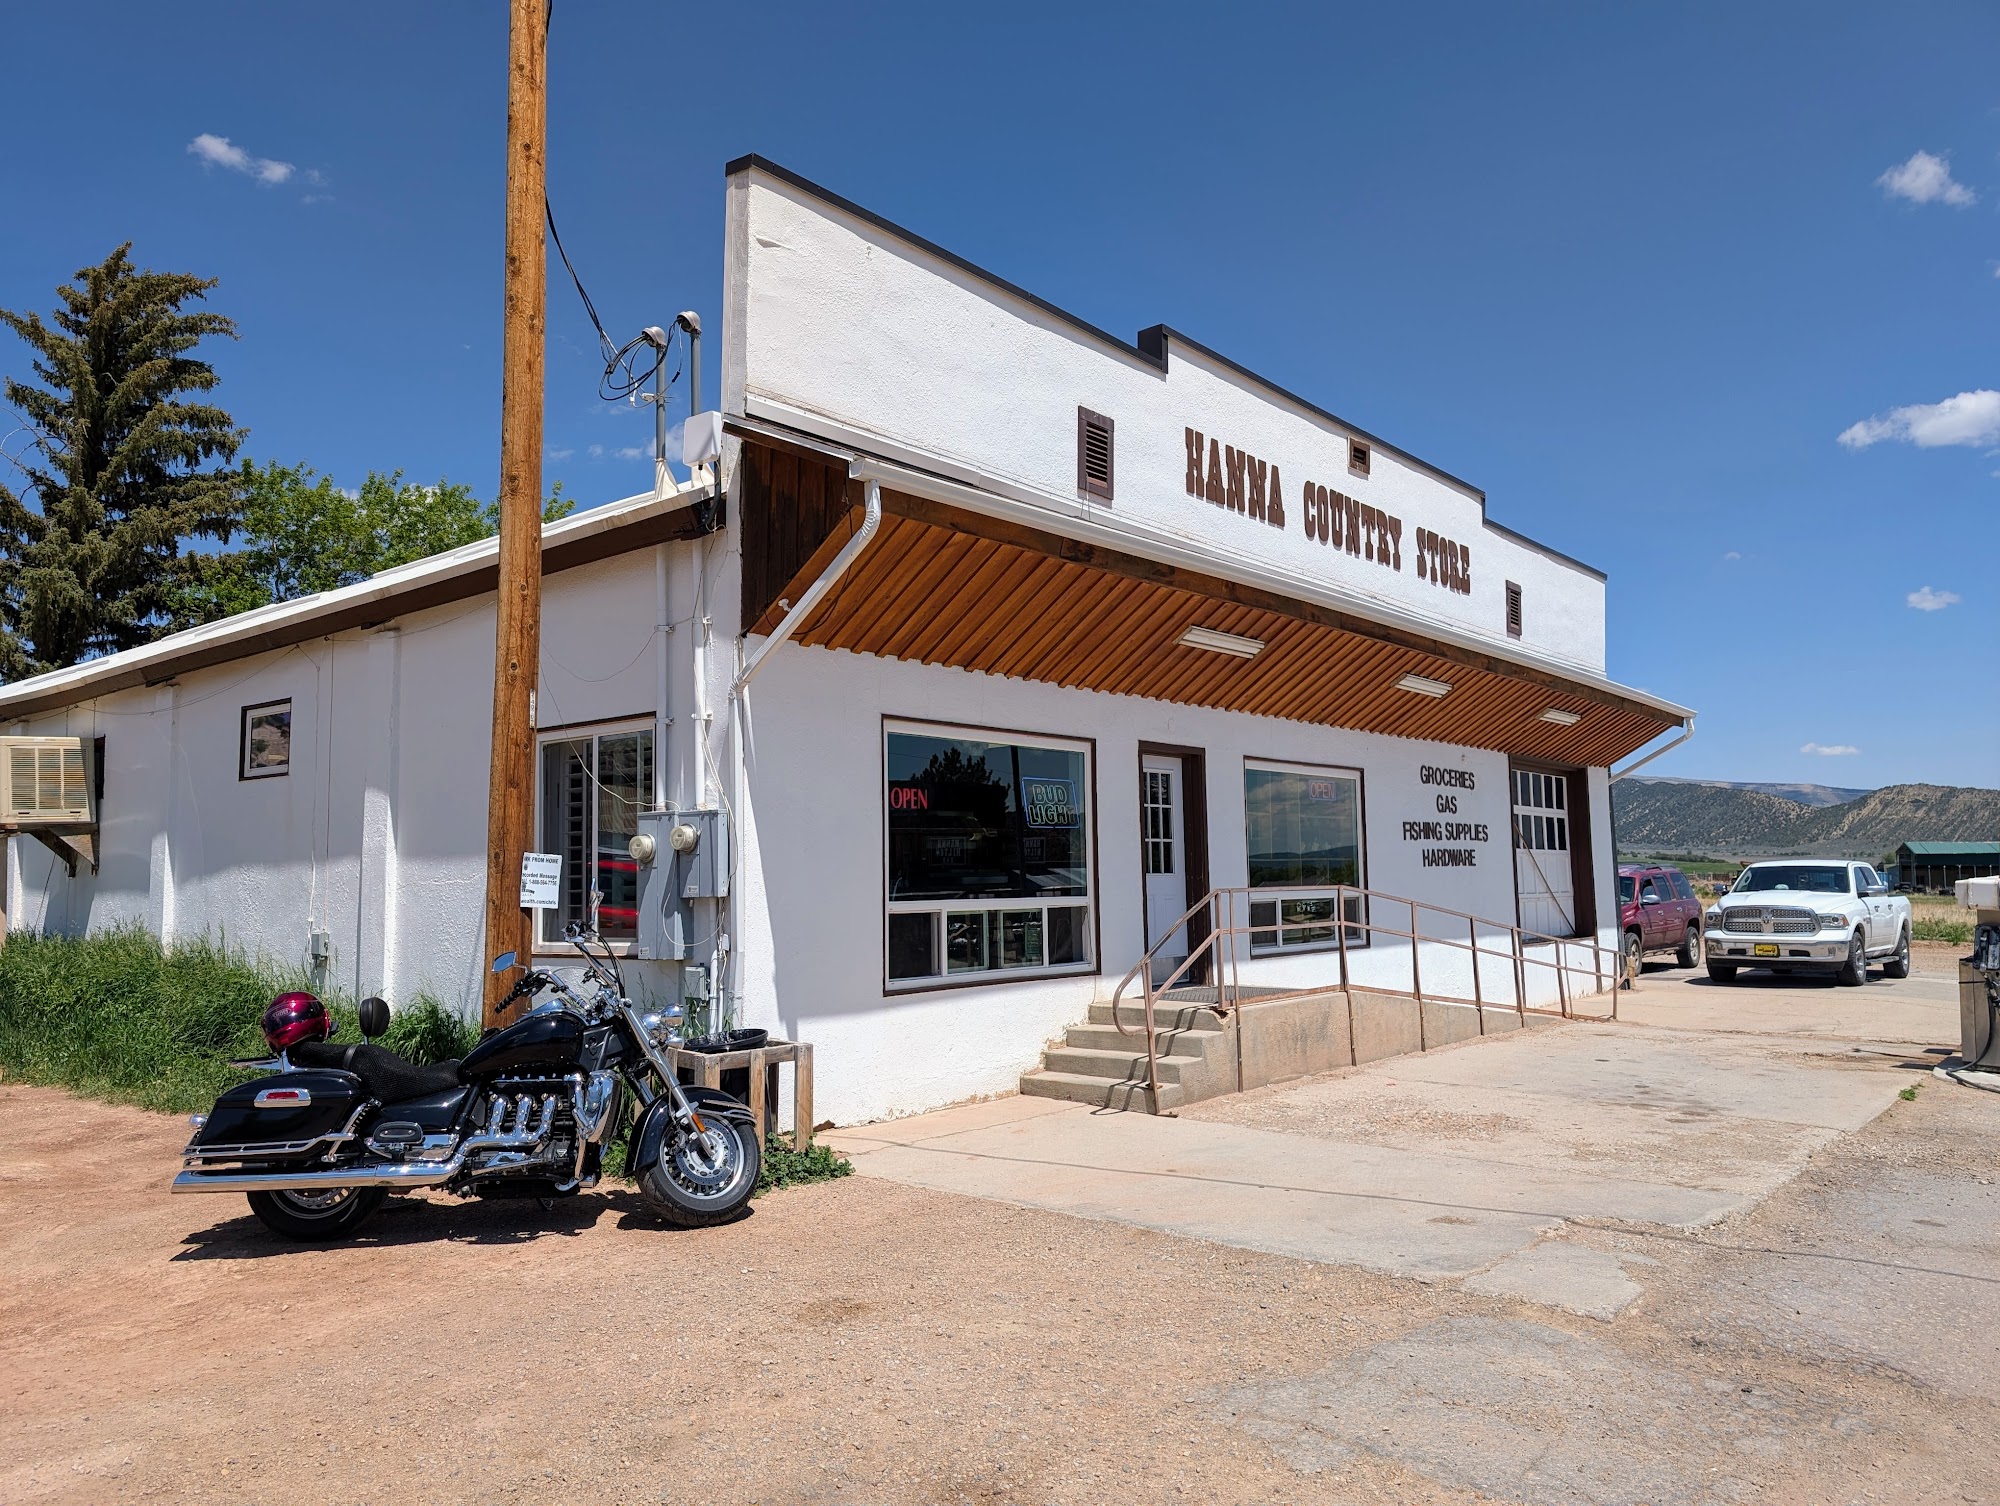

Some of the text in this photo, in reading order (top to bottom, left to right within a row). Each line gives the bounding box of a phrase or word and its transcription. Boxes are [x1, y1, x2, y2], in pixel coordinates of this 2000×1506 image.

[1185, 426, 1471, 594] HANNA COUNTRY STORE
[1420, 765, 1475, 790] GROCERIES
[890, 787, 928, 810] OPEN
[1032, 784, 1067, 804] BUD
[1311, 782, 1335, 799] OPEN
[1028, 804, 1077, 825] LIGHT
[1436, 794, 1458, 814] GAS
[1402, 821, 1489, 842] FISHING SUPPLIES
[1422, 848, 1477, 867] HARDWARE
